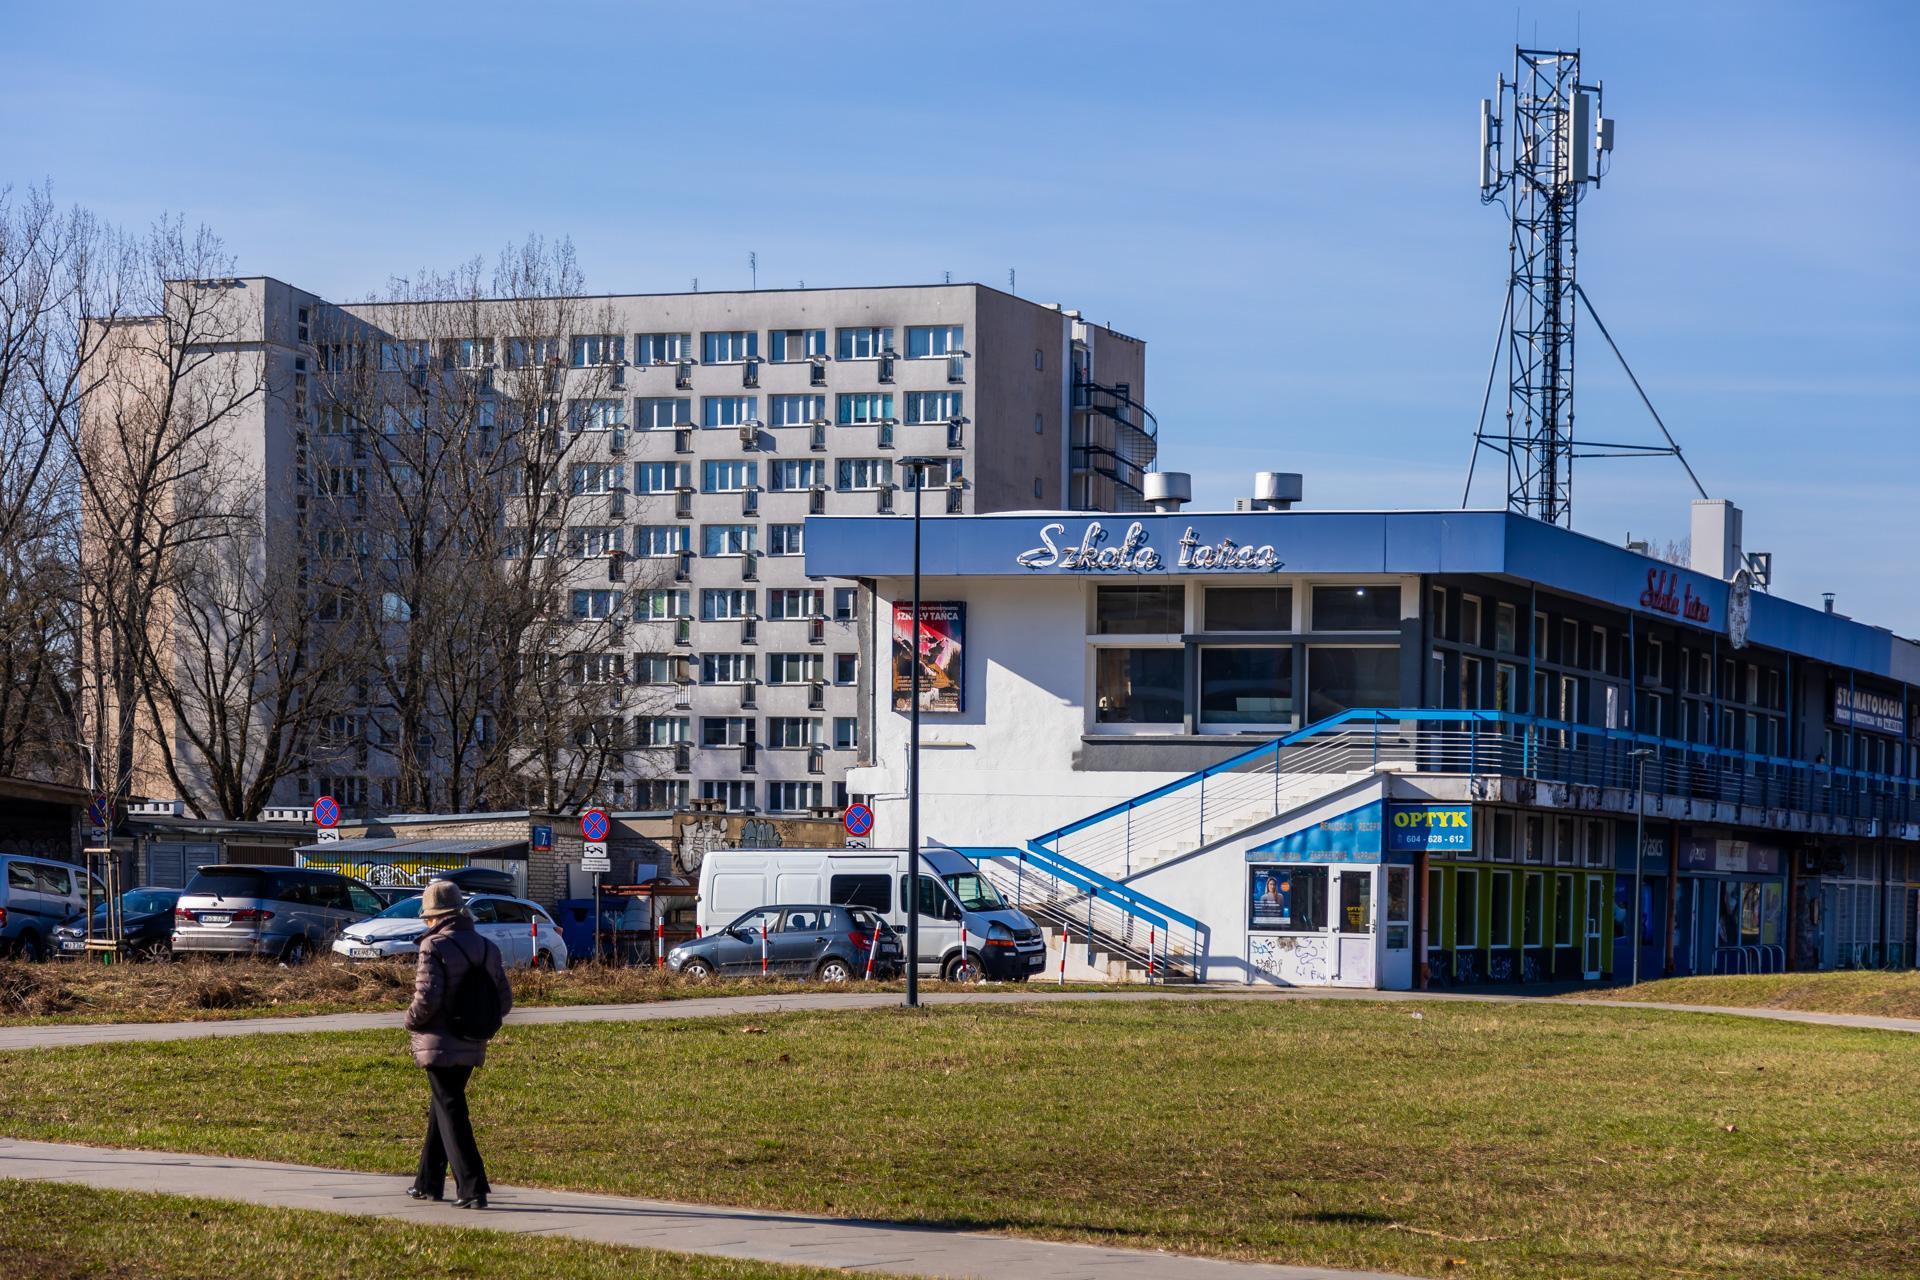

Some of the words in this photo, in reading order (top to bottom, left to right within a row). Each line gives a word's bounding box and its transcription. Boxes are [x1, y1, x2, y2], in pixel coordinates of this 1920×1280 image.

[896, 611, 929, 620] SZKŁY
[930, 610, 959, 621] TAŃCA
[1394, 811, 1468, 828] OPTYK
[1406, 835, 1421, 843] 604
[1428, 835, 1443, 843] 628
[1449, 835, 1464, 843] 612
